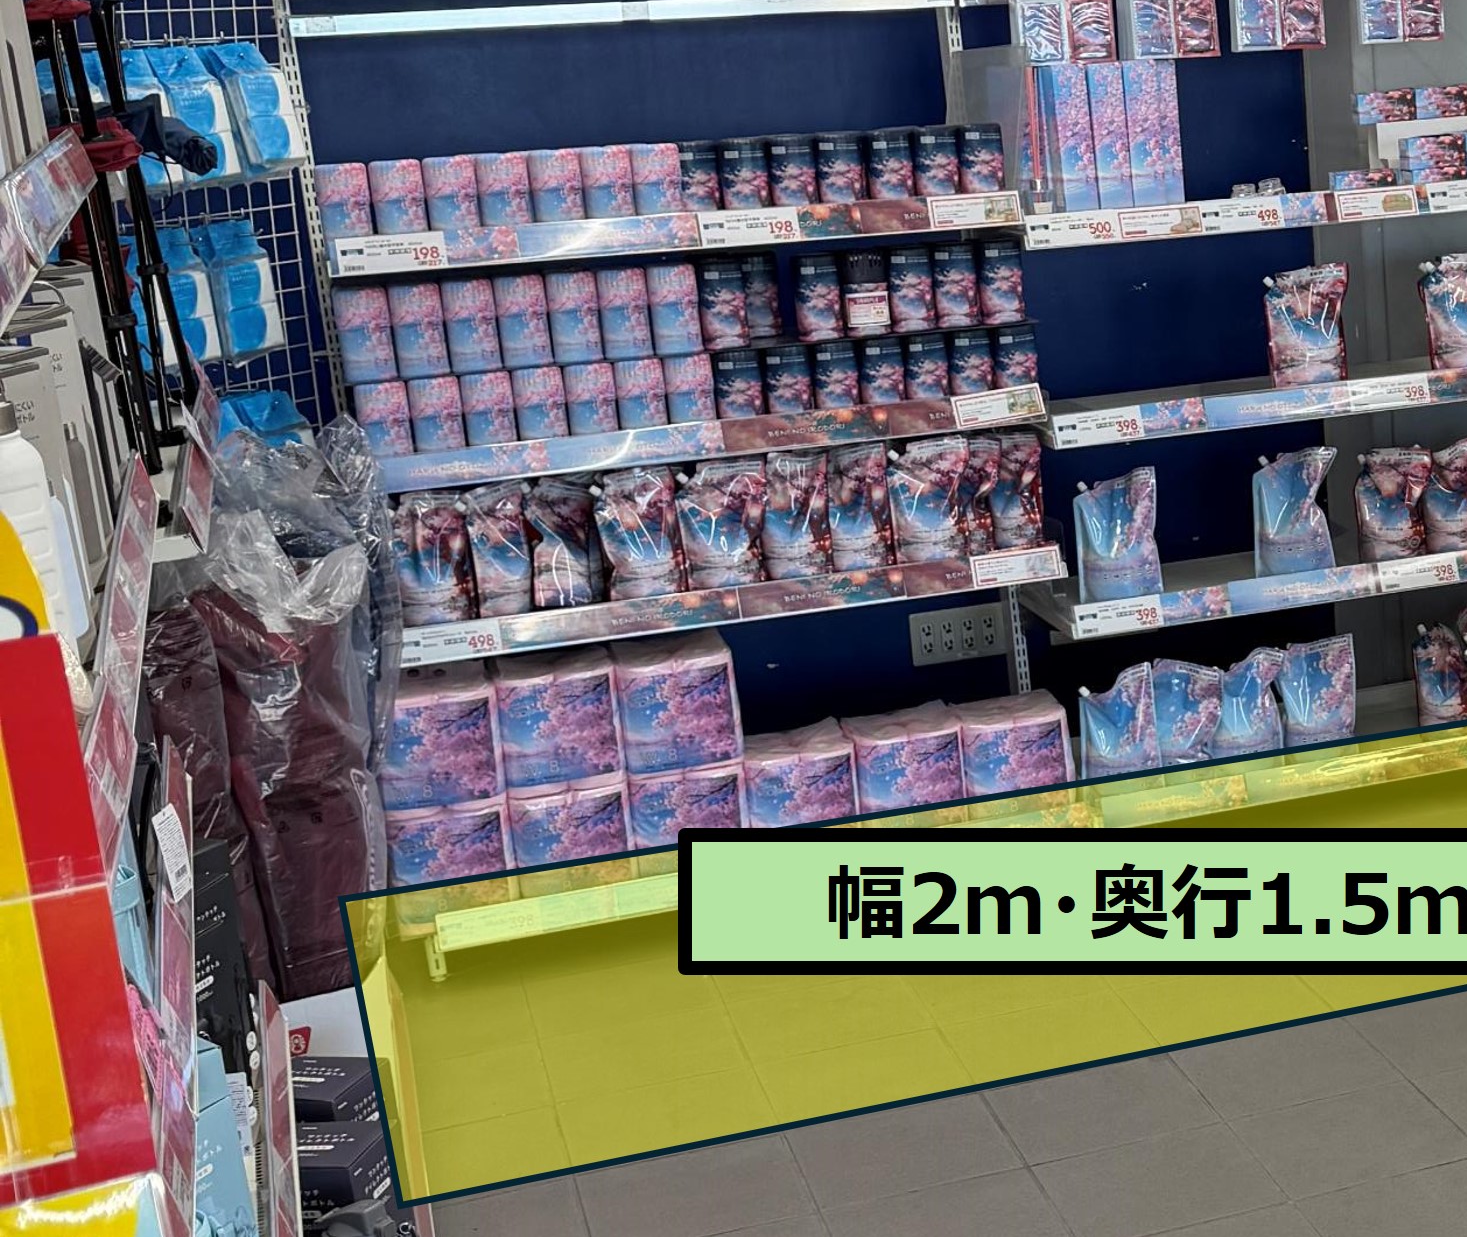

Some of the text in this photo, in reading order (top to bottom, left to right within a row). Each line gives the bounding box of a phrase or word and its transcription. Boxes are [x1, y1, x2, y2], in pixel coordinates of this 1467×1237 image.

[1257, 208, 1279, 222] 498
[768, 220, 795, 237] 198
[1088, 221, 1112, 235] 500
[412, 246, 440, 261] 198
[1115, 418, 1138, 433] 398
[1432, 563, 1455, 579] 398
[1136, 606, 1158, 621] 398
[467, 634, 498, 649] 498
